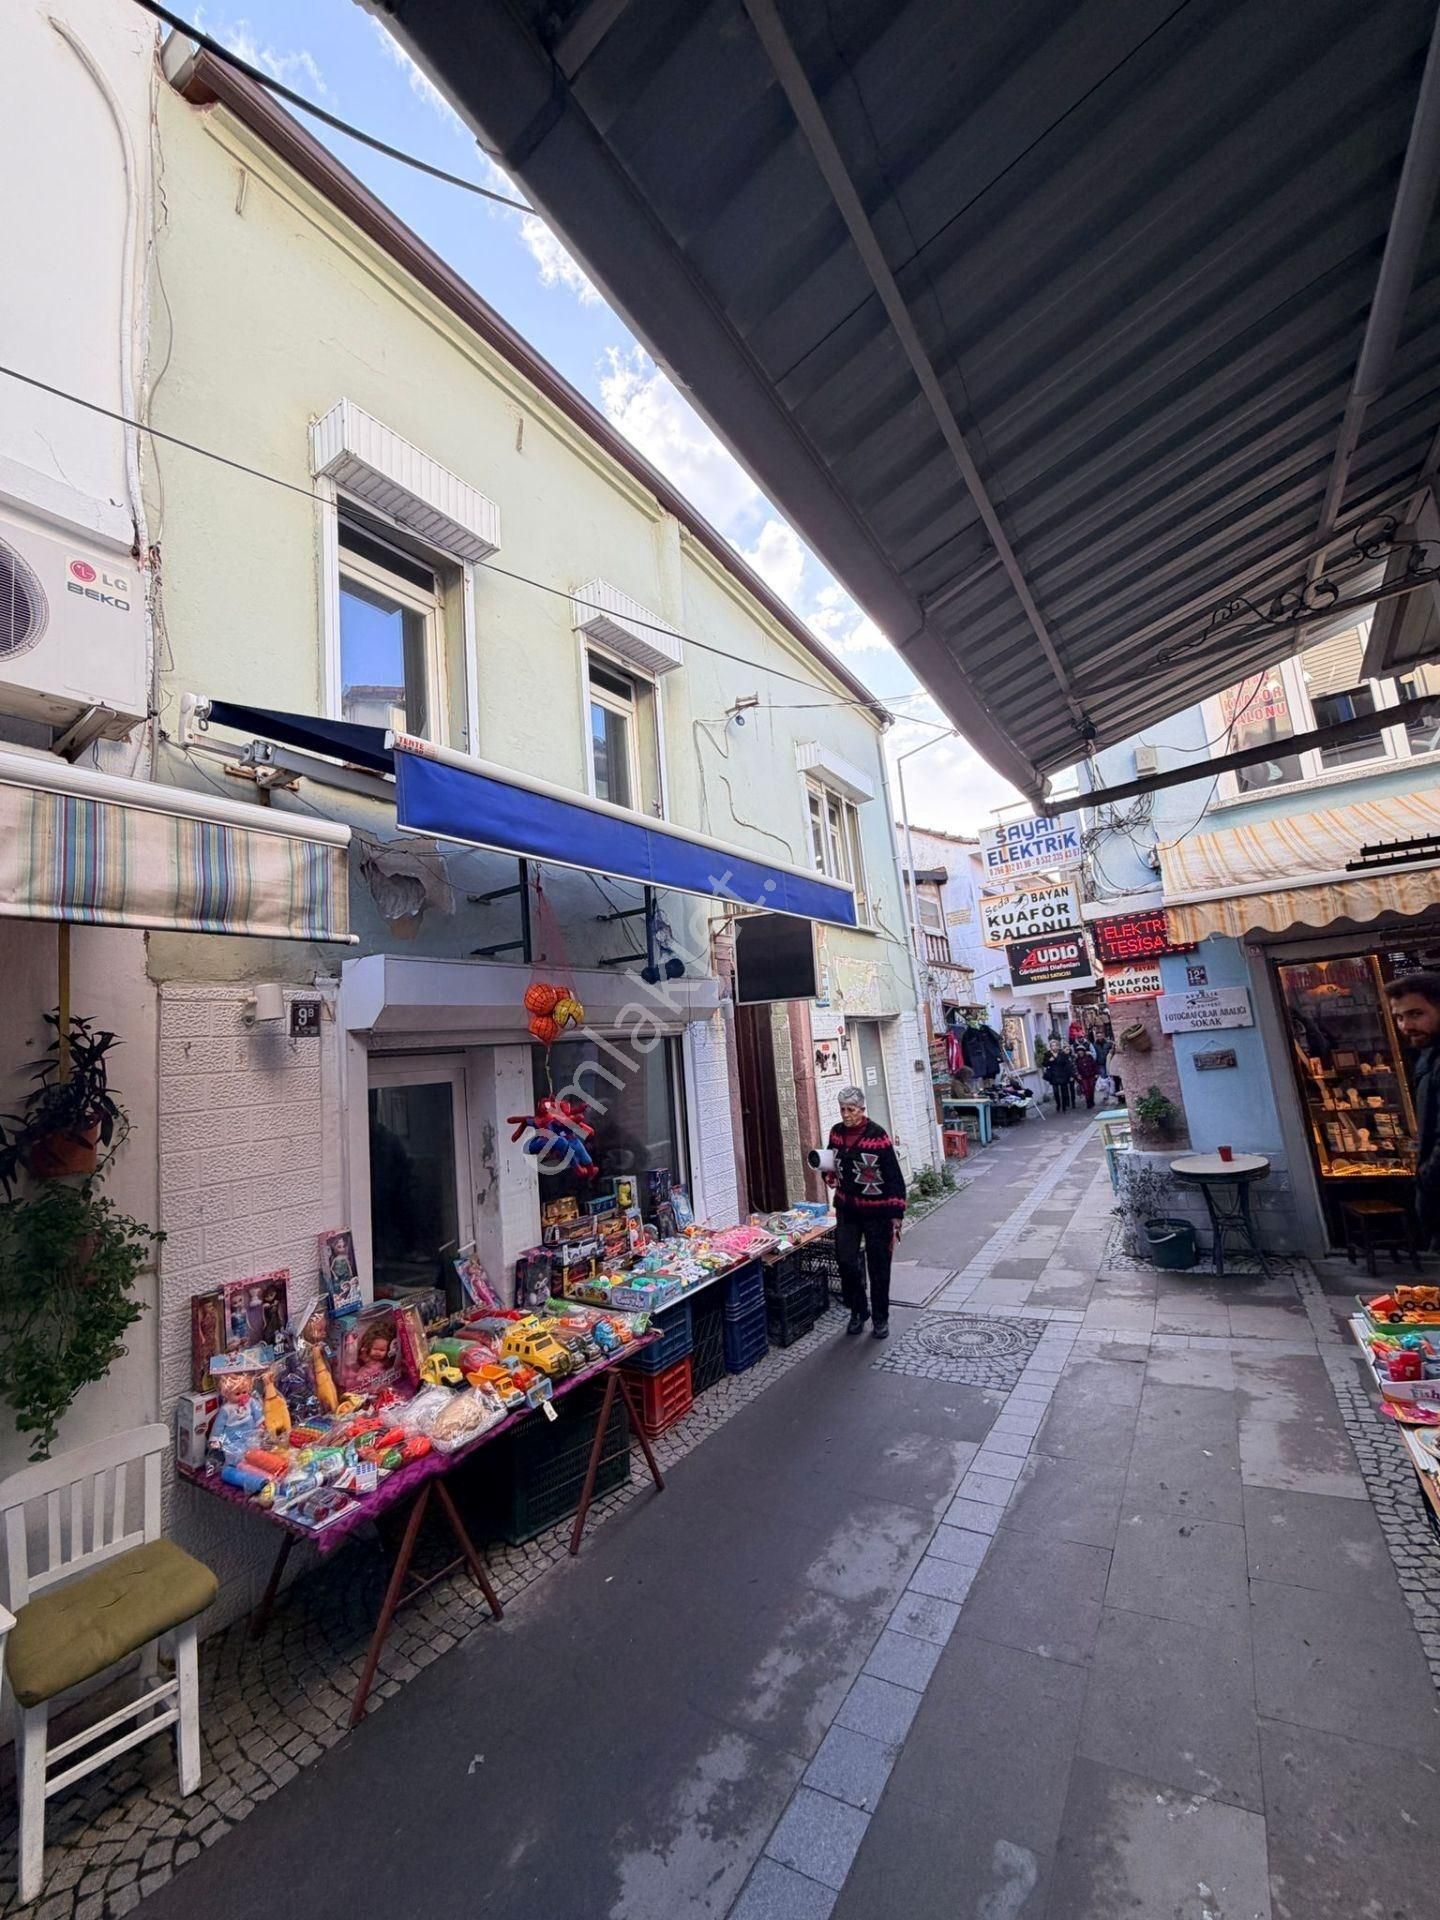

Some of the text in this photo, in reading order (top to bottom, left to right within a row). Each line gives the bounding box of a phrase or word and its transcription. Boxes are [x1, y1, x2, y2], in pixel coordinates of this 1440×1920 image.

[102, 573, 128, 592] LG
[67, 581, 130, 612] BEKO
[1031, 886, 1069, 903] BAYAN
[988, 903, 1070, 928] KUAFÖR
[990, 917, 1071, 941] SALONU
[1020, 945, 1079, 968] AUDIO
[1108, 975, 1159, 988] KUAFÖR
[1109, 983, 1160, 996] SALONU
[1190, 1017, 1222, 1028] SOKAK
